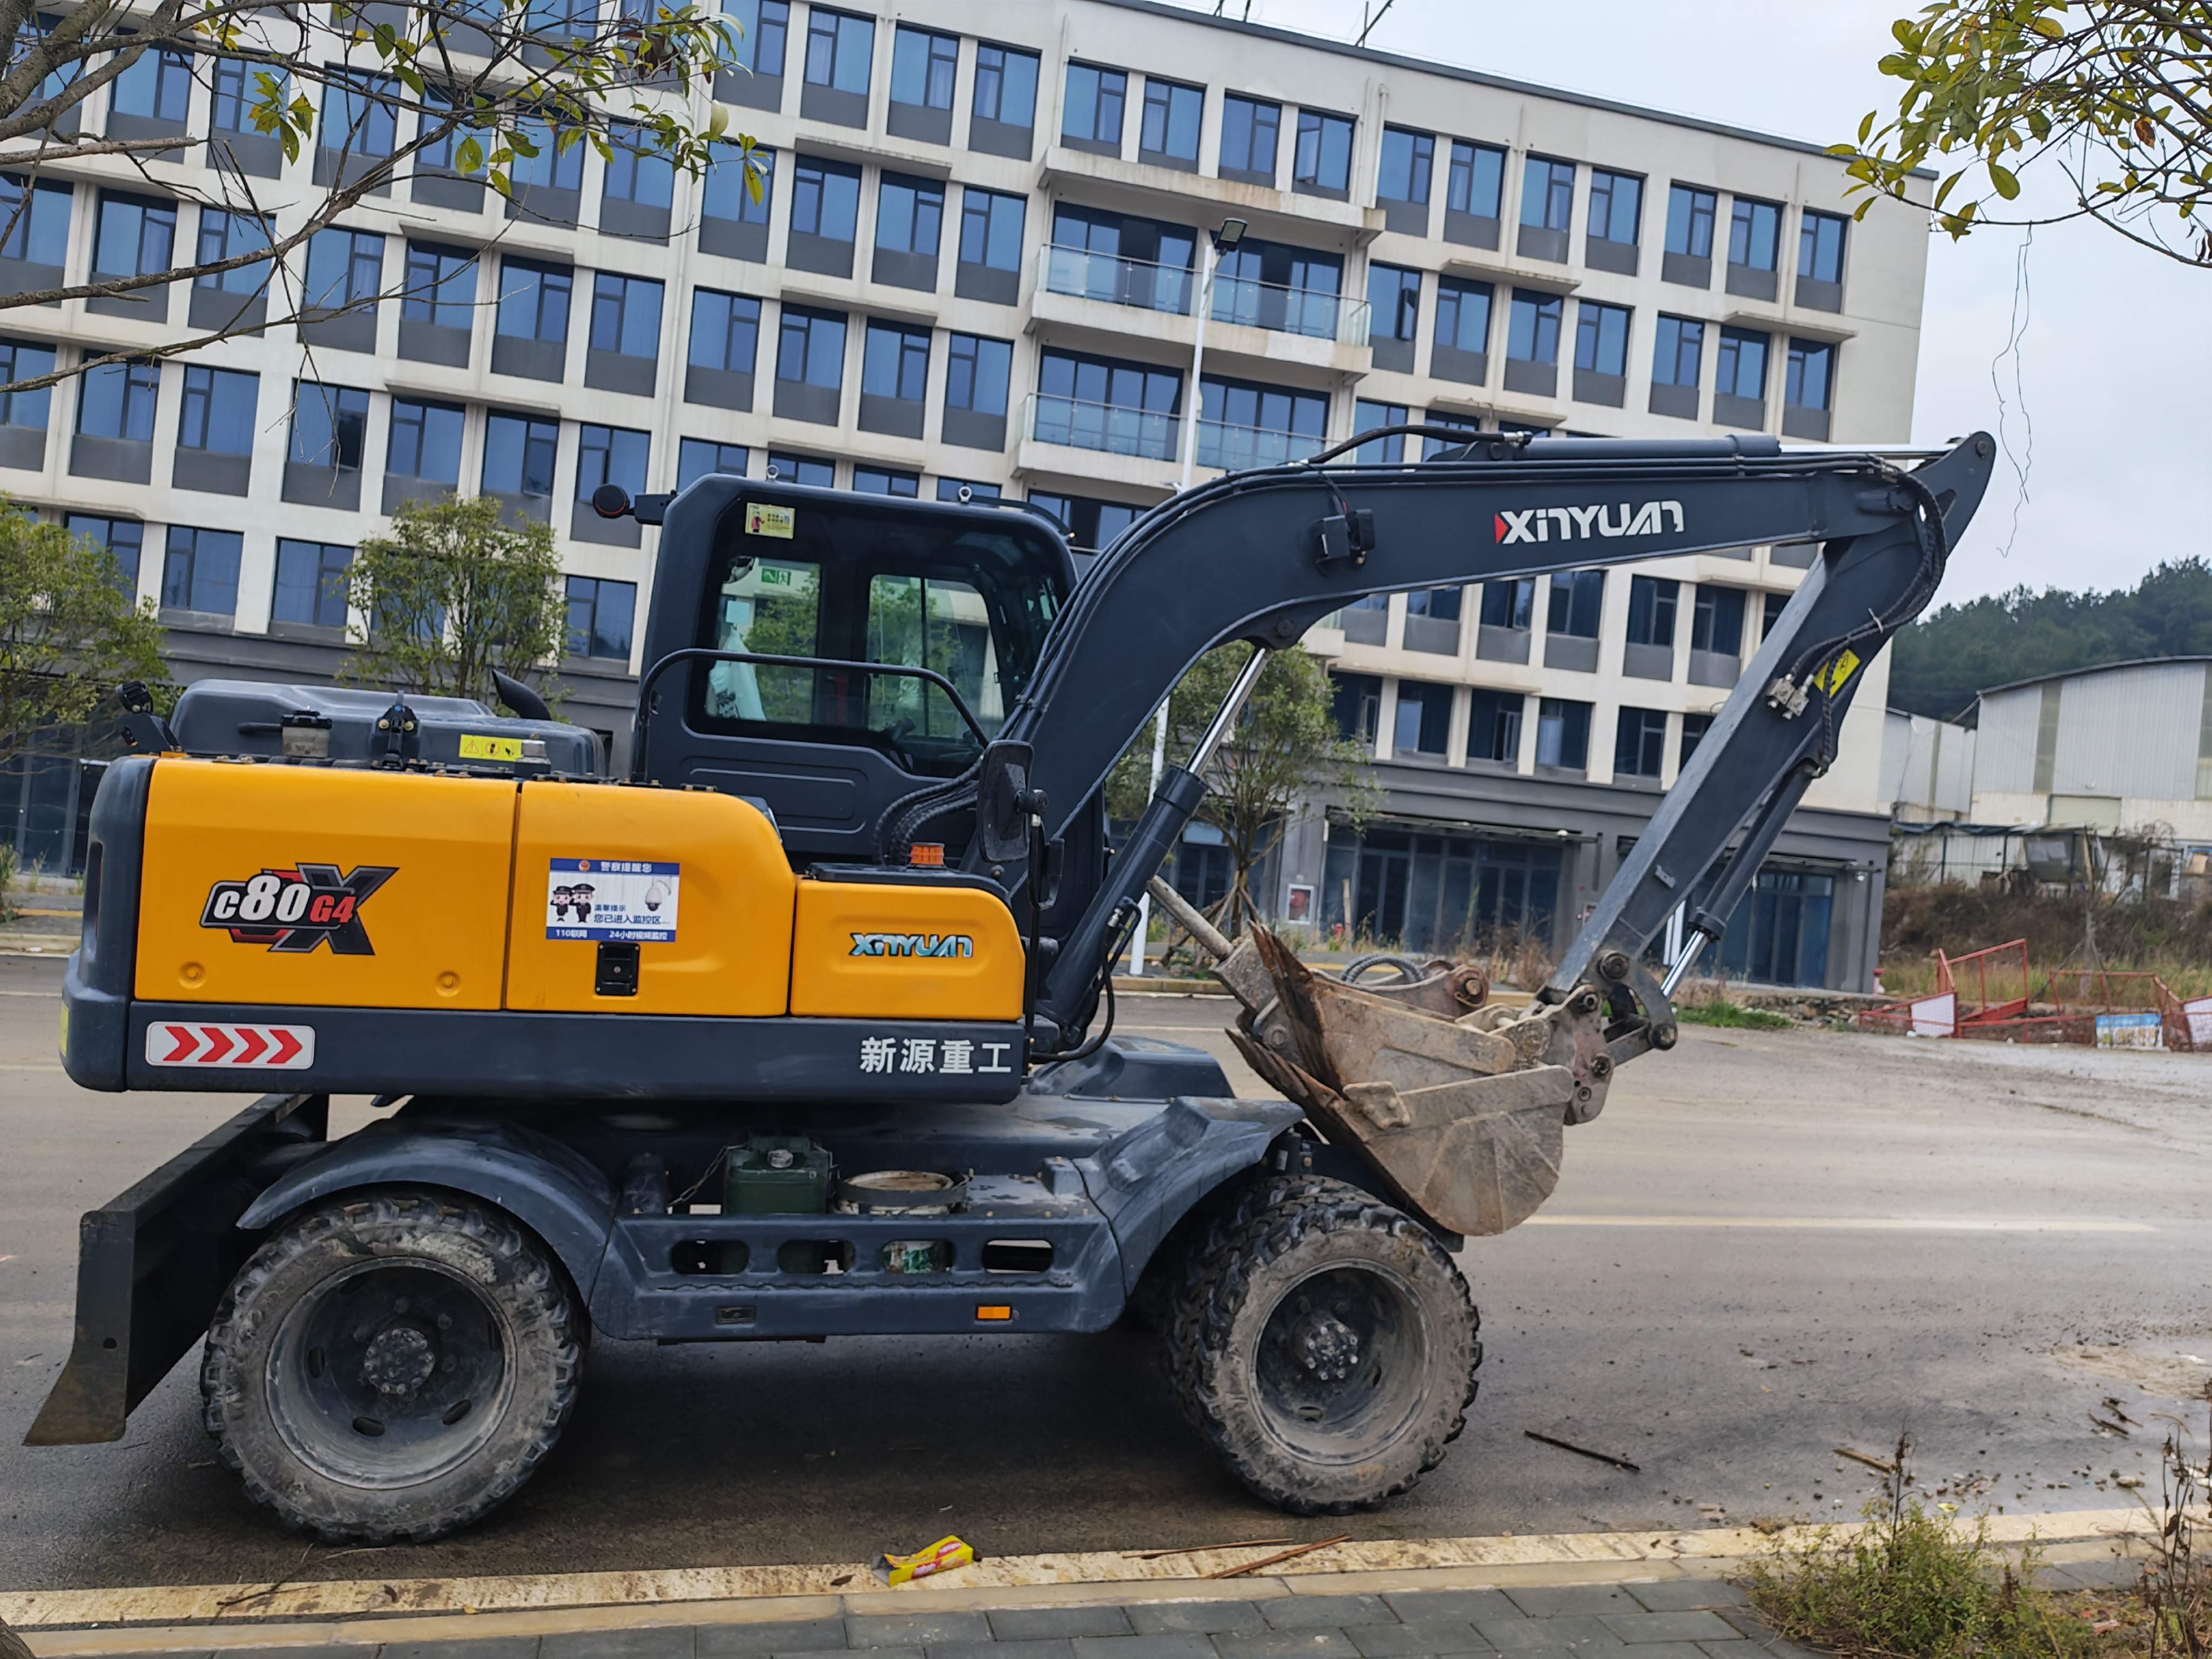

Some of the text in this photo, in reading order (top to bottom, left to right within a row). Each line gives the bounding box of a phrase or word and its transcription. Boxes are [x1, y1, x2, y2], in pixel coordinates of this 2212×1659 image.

[309, 894, 356, 923] G4
[860, 1037, 1011, 1074] 新源重工
